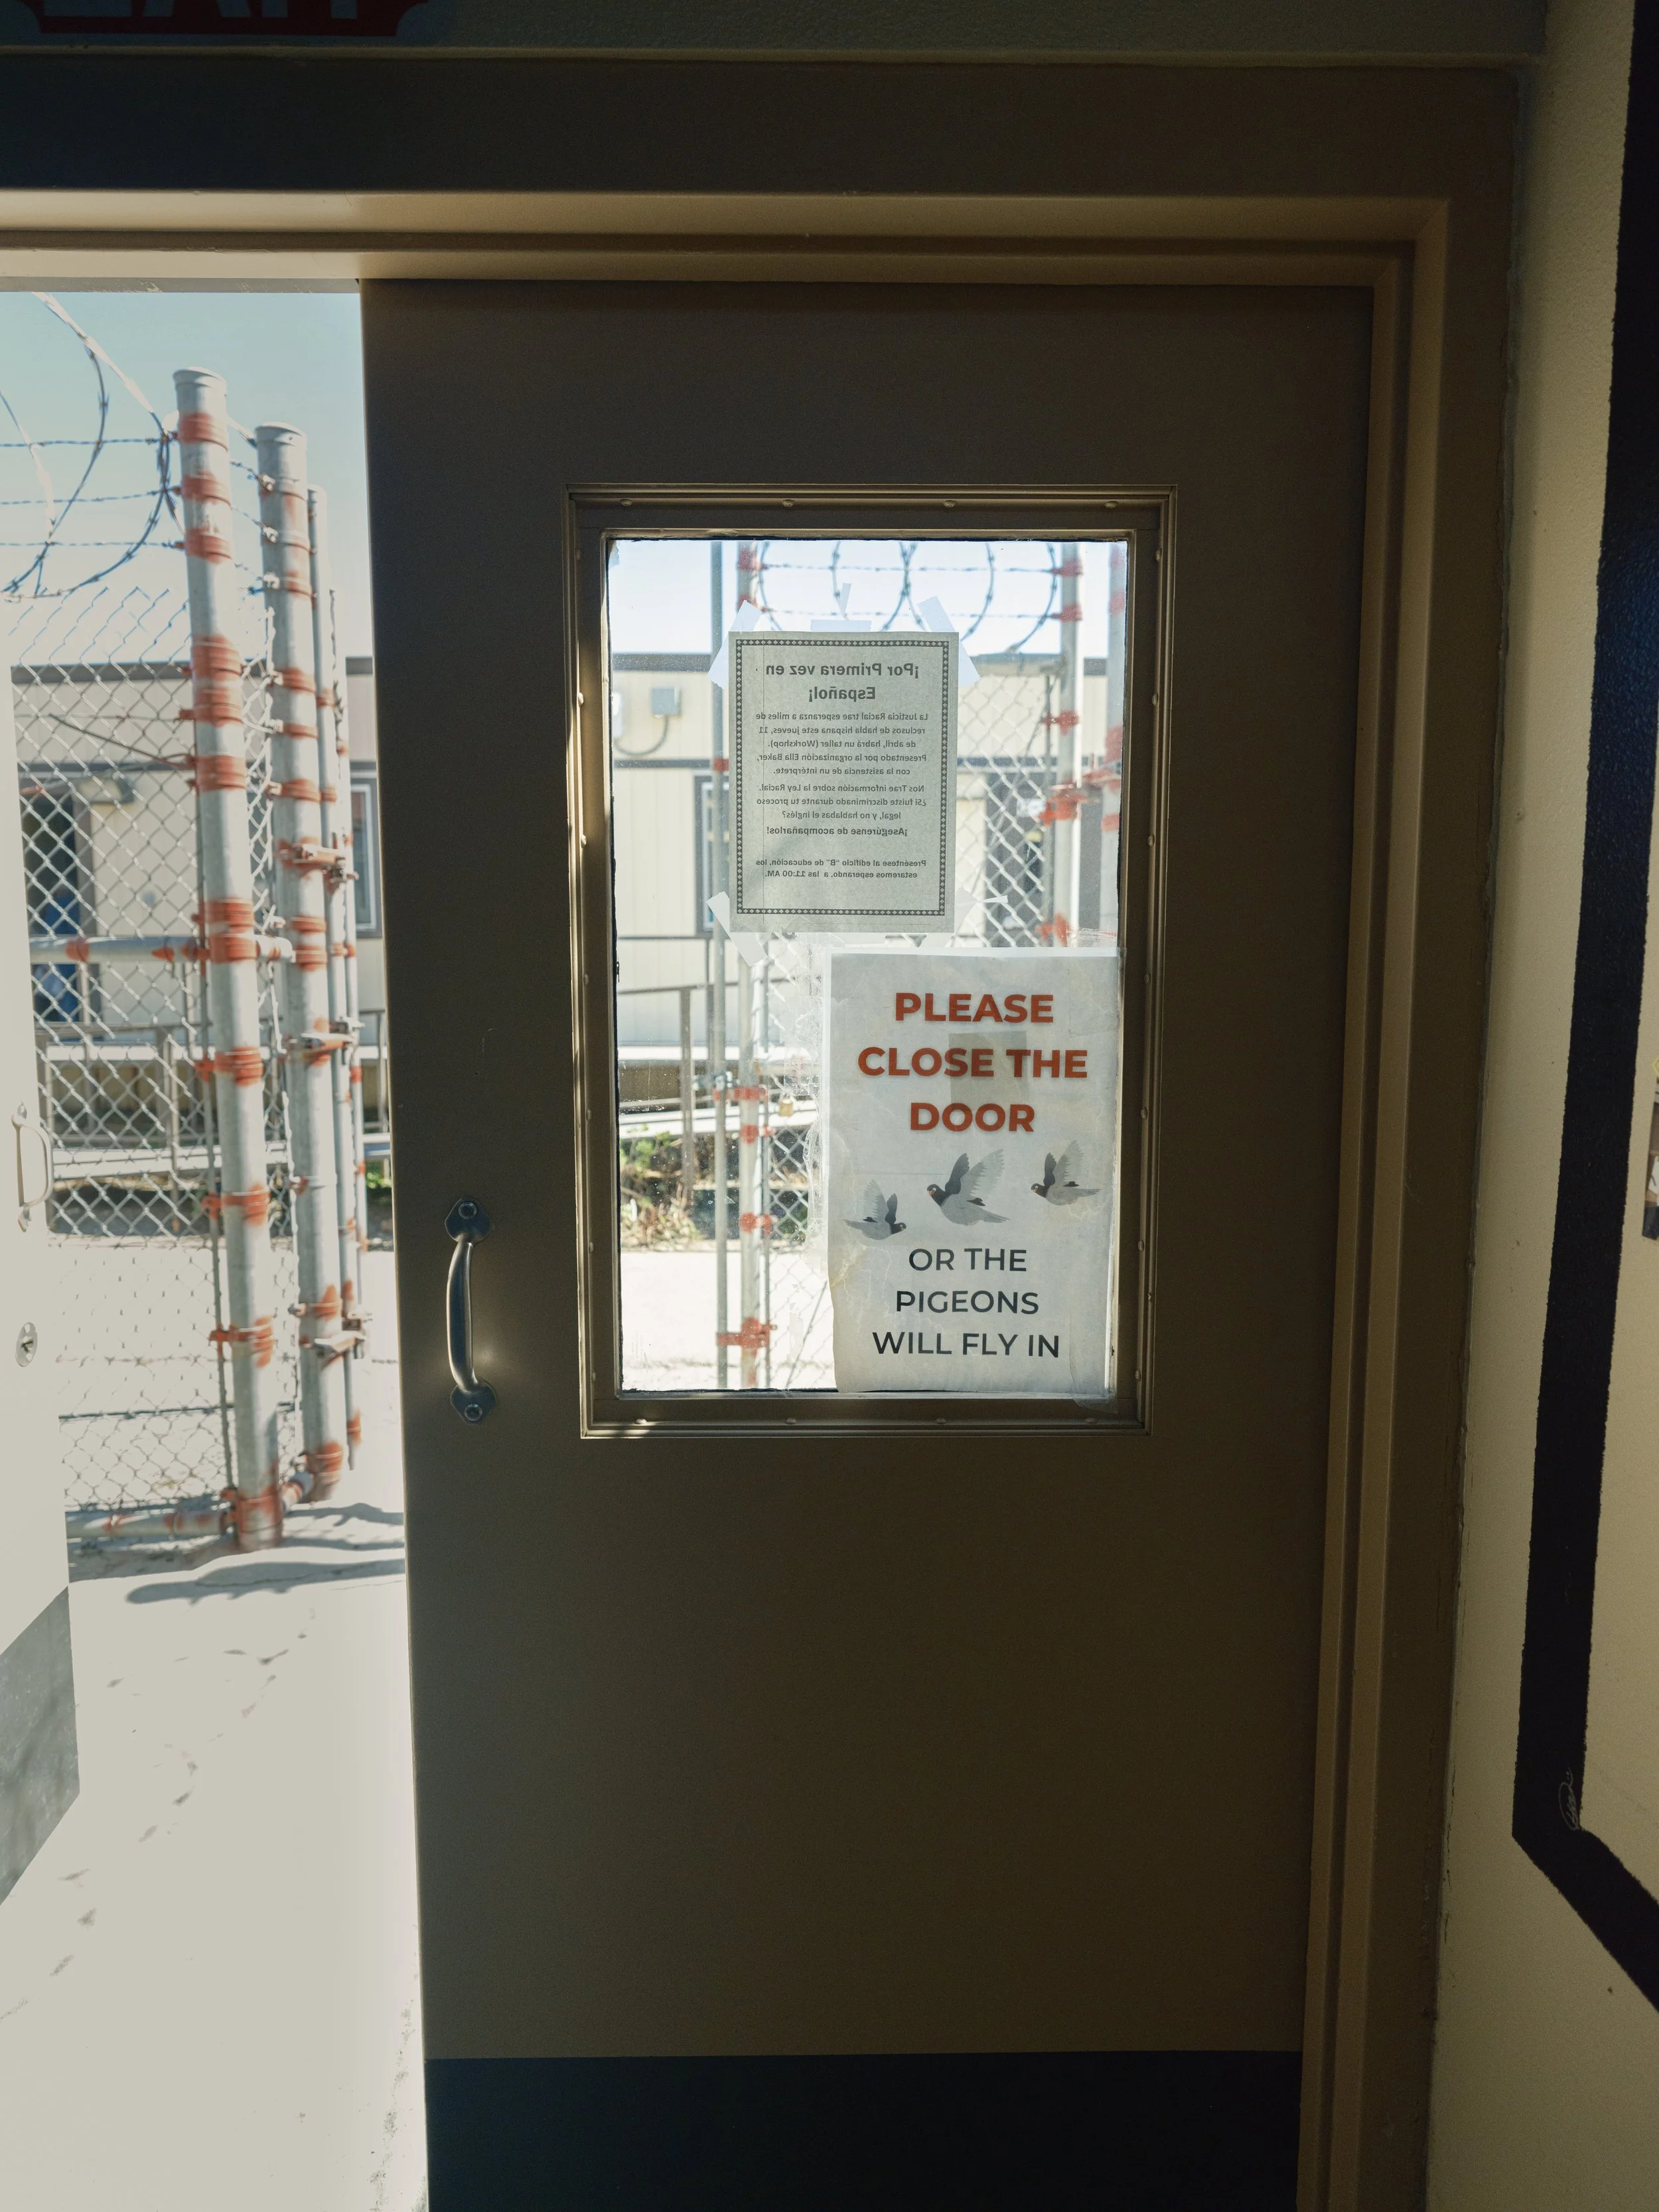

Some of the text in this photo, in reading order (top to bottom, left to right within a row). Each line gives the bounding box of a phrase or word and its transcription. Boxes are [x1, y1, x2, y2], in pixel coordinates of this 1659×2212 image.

[895, 992, 1054, 1023] PLEASE
[857, 1047, 1088, 1078] CLOSE THE
[910, 1102, 1035, 1132] DOOR
[908, 1248, 1027, 1272] OR THE
[896, 1290, 1039, 1315] PIGEONS
[872, 1331, 1059, 1359] WILL FLY IN
